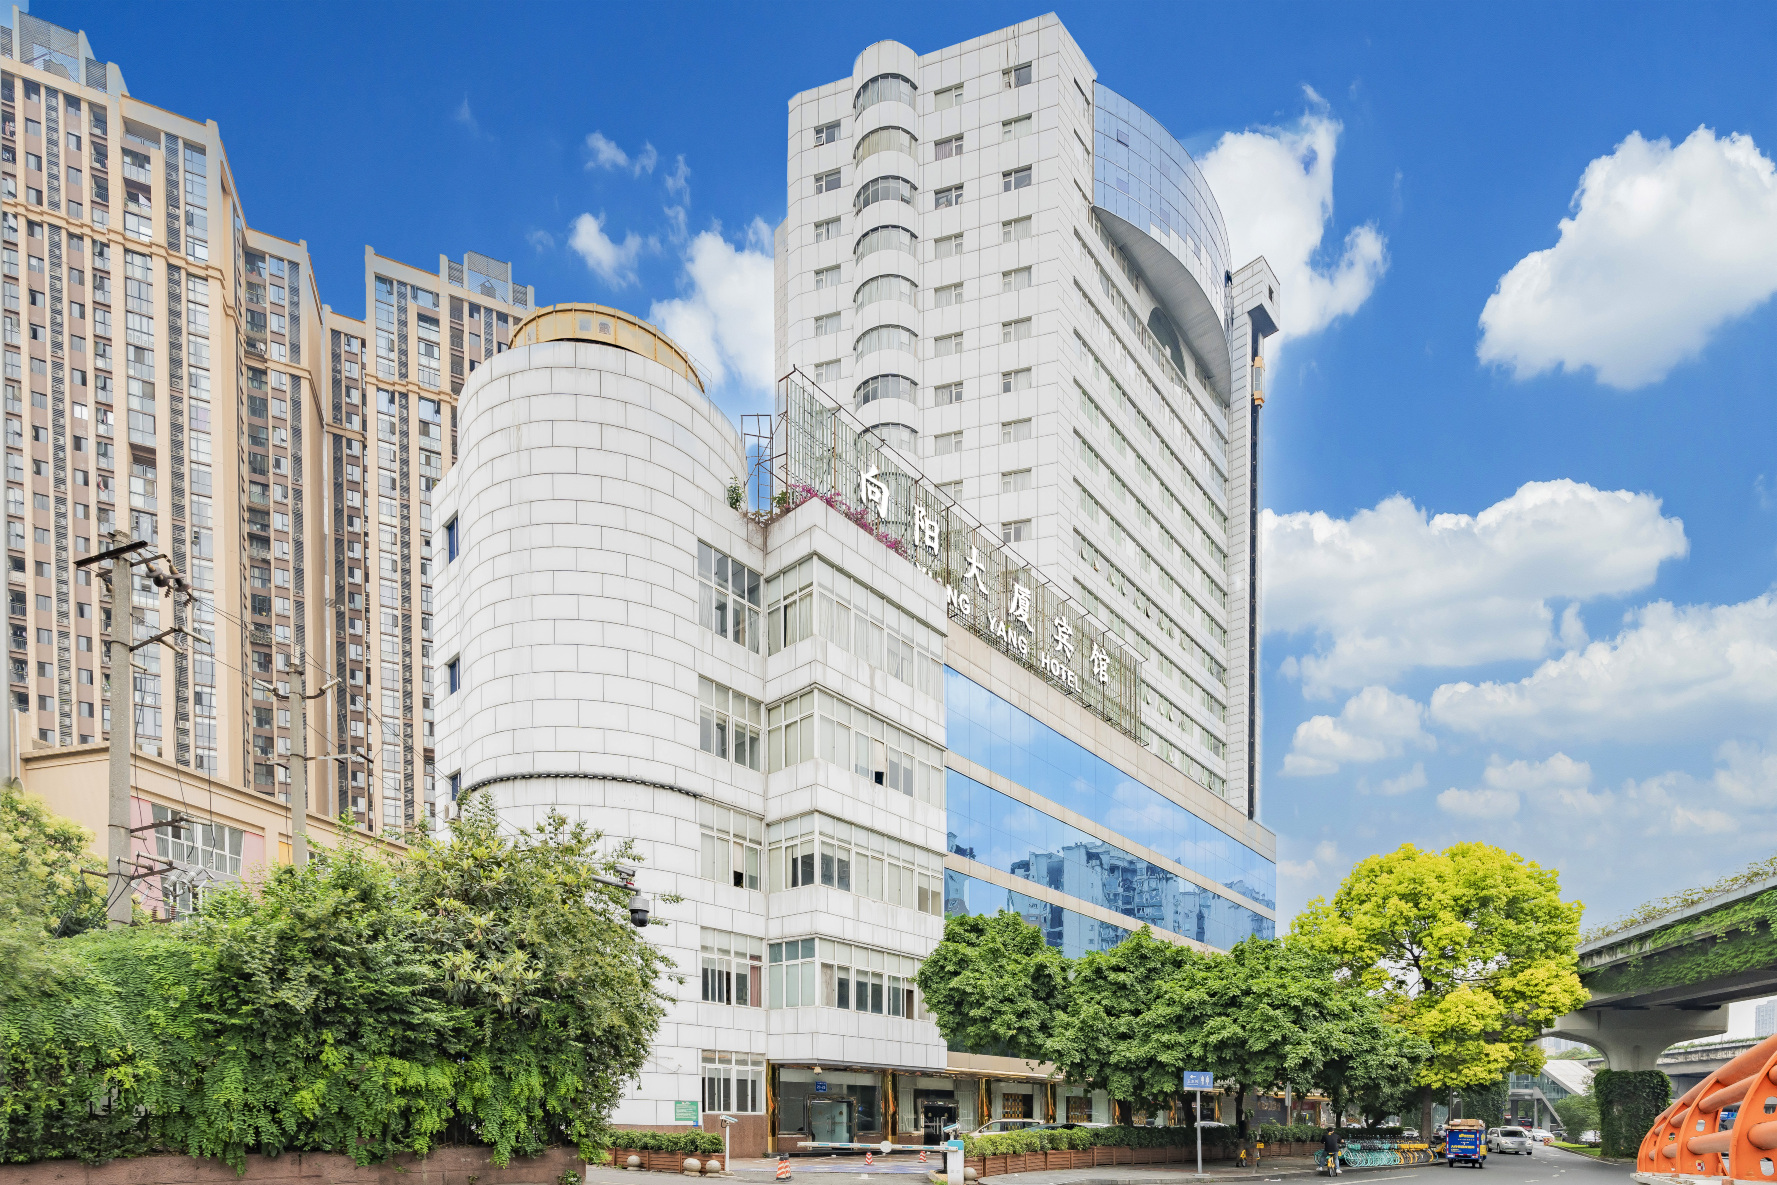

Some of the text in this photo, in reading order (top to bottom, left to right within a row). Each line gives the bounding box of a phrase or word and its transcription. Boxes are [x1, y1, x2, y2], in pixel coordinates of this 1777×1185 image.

[860, 463, 1110, 682] 向阳大厦宾馆
[987, 611, 1081, 693] YANG HOTEL
